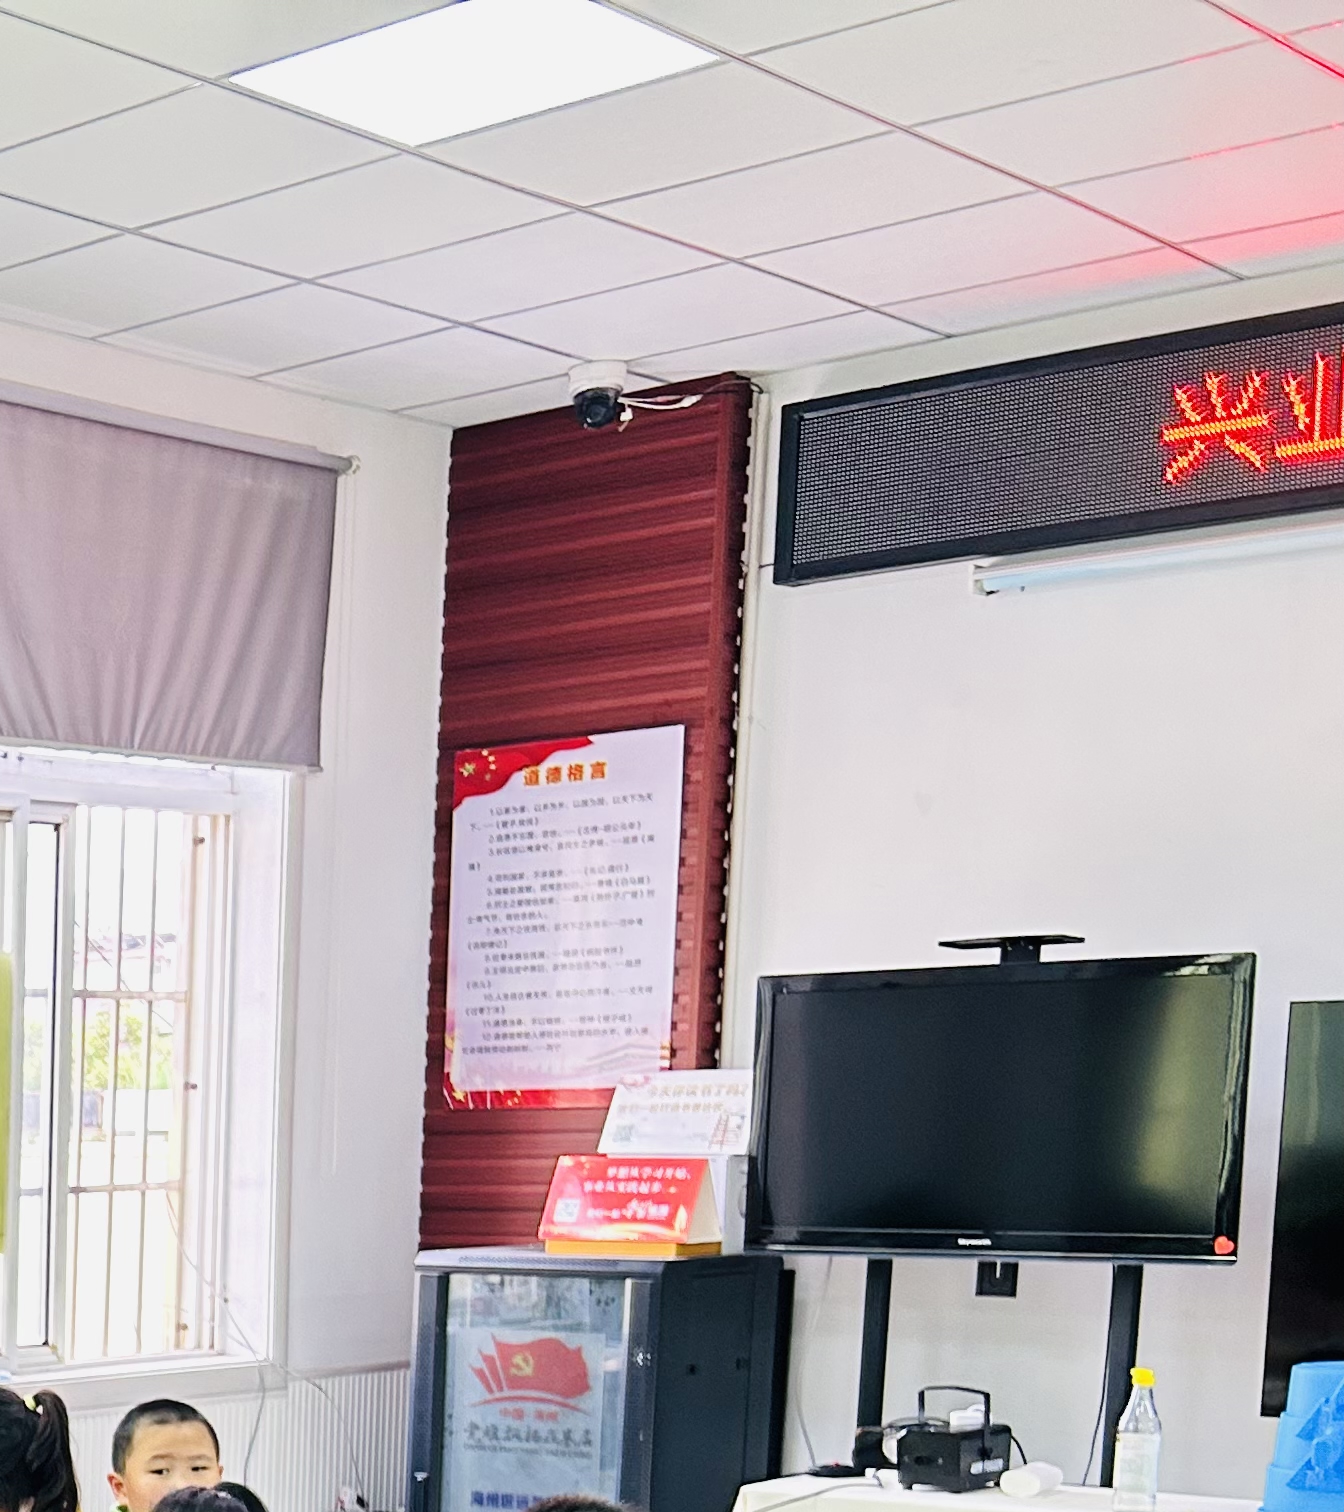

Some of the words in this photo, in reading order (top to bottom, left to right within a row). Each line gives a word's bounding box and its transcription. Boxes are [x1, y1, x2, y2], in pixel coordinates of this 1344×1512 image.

[1161, 349, 1344, 485] 兴业
[523, 761, 607, 787] 道德格言
